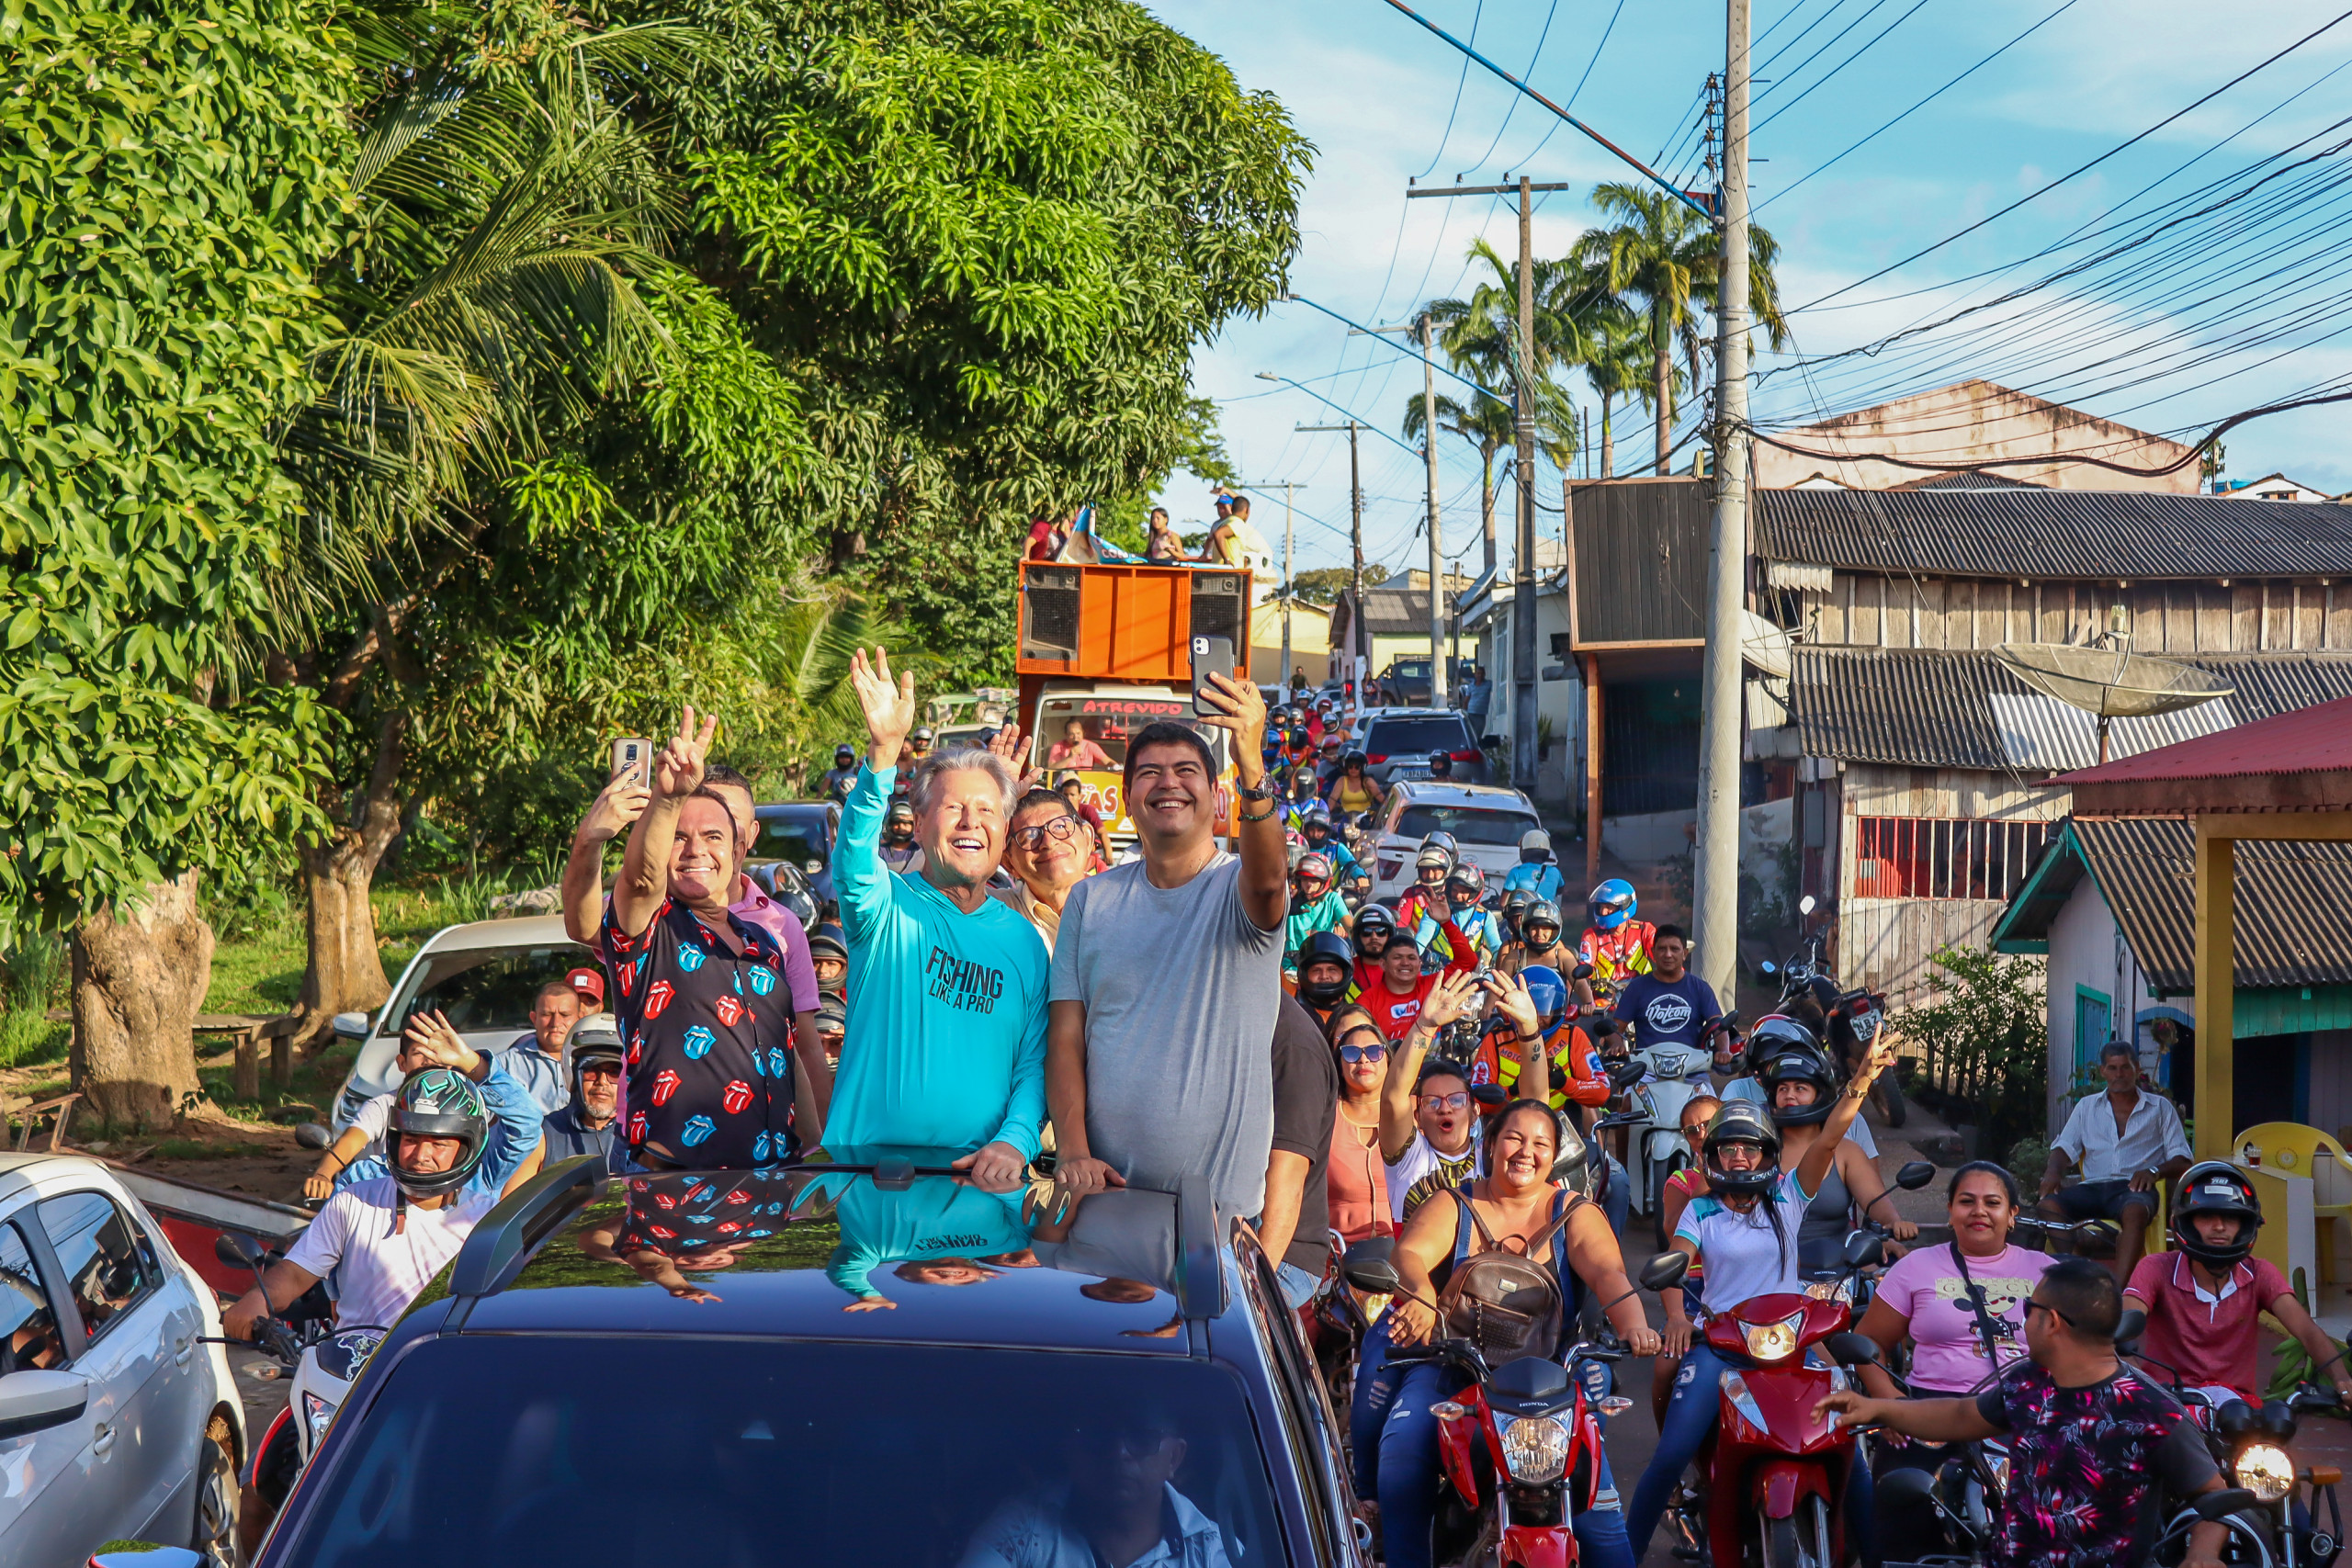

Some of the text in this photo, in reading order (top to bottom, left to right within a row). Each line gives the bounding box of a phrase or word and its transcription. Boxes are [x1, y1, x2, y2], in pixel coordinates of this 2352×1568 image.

[1082, 700, 1183, 716] ATREVIDO
[1600, 939, 1641, 962] MOTO TAXI
[925, 944, 1004, 999] FISHING
[928, 978, 995, 1015] LIKE A PRO
[1859, 1026, 1876, 1040] 26
[1547, 1039, 1567, 1056] TAXI
[1942, 1283, 2031, 1294] GCCI
